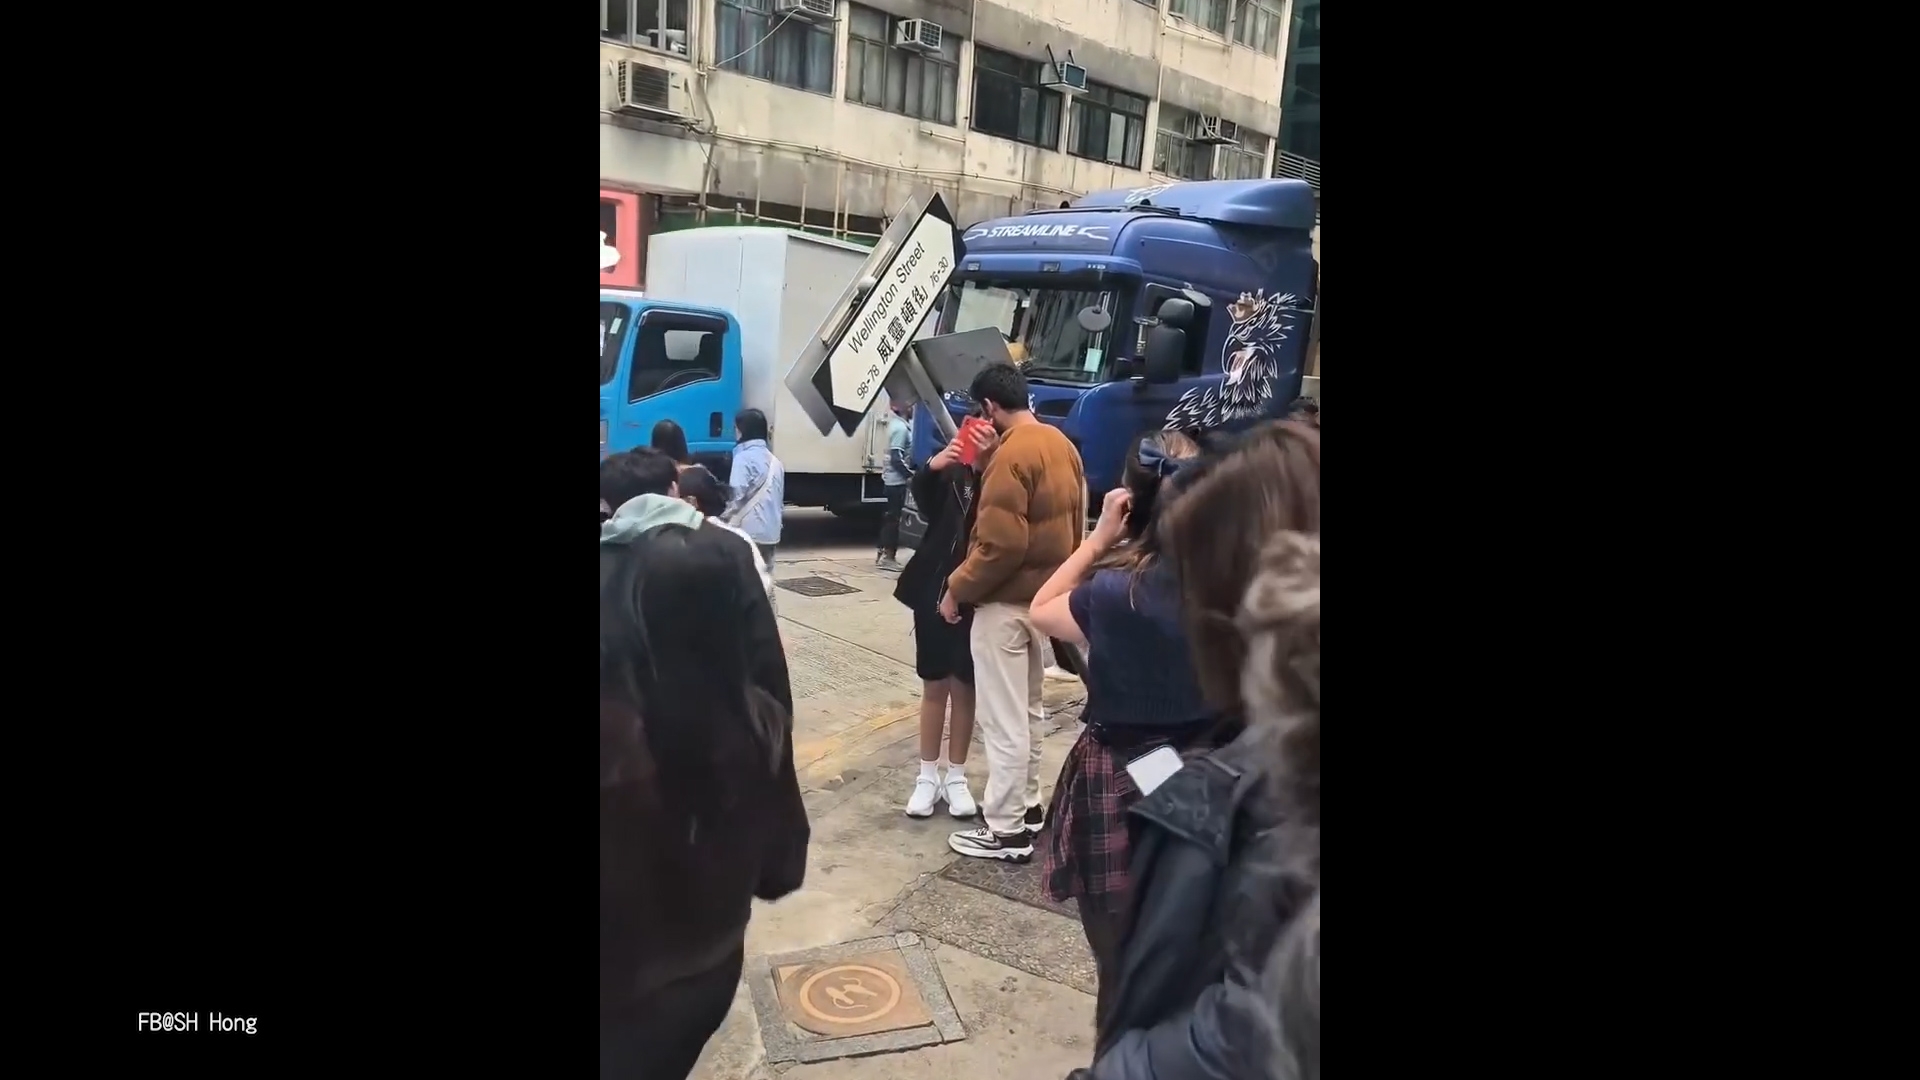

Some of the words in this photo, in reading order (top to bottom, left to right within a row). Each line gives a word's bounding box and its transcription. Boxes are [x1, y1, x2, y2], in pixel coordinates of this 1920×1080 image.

[987, 225, 1078, 238] STREAMLINE
[848, 284, 898, 354] Wellington
[896, 241, 926, 284] Street
[856, 364, 880, 400] 98-78
[876, 285, 929, 364] 威靈頓街
